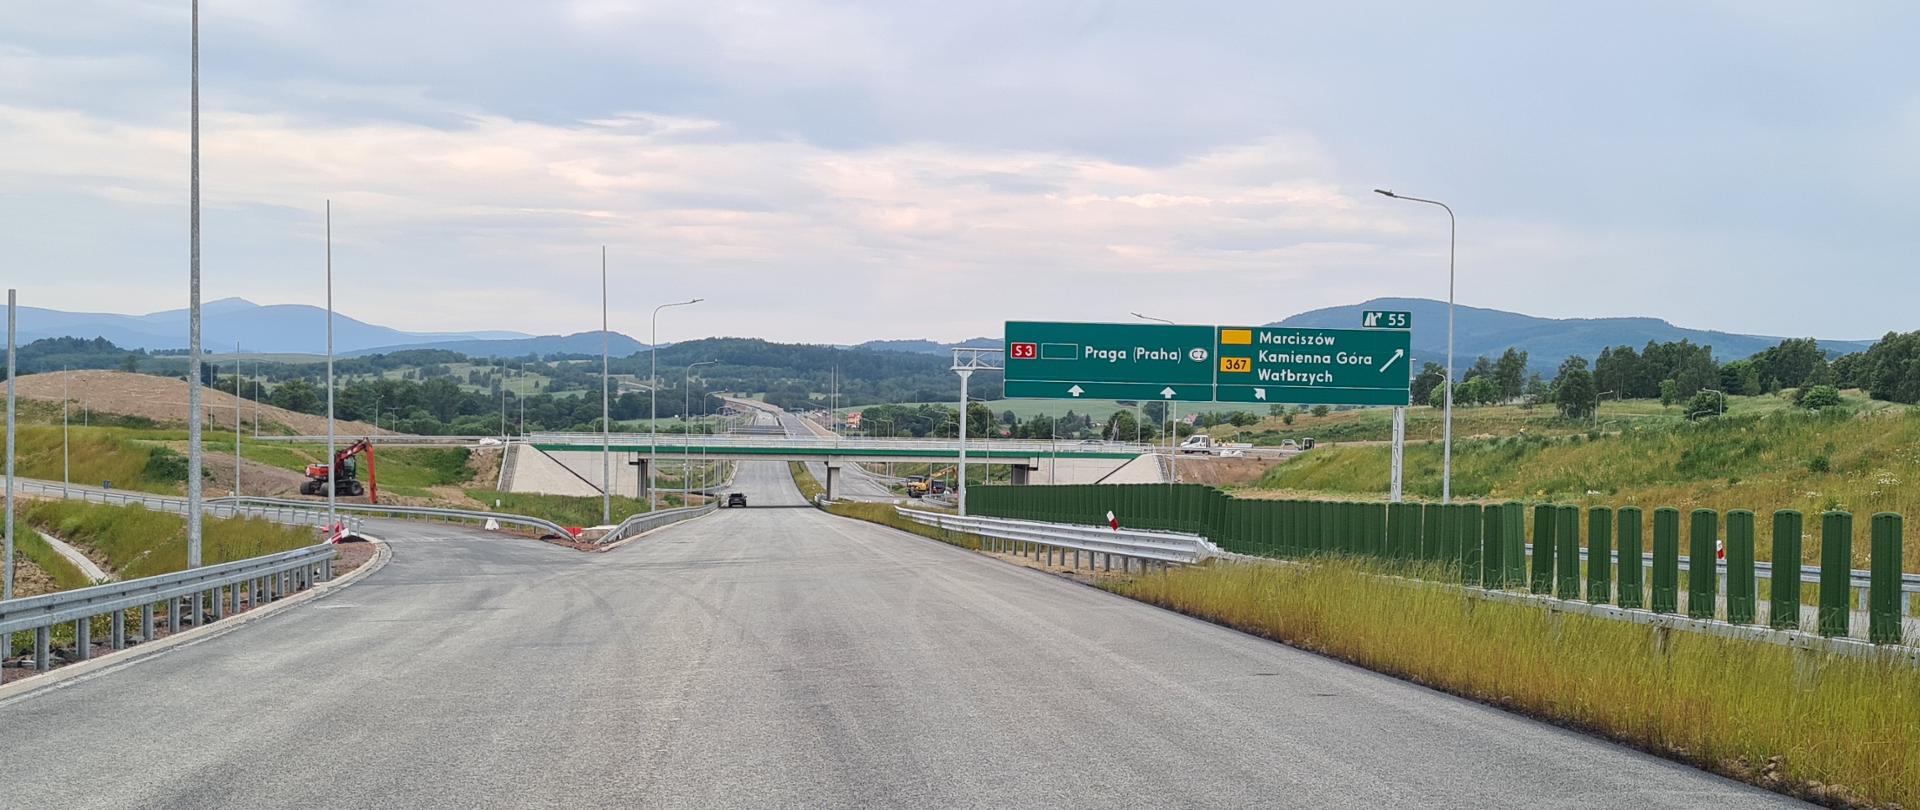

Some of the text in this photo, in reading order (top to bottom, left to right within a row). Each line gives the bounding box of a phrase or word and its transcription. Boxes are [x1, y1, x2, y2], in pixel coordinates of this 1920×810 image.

[1388, 313, 1406, 326] 55
[1259, 331, 1336, 346] Marciszów
[1084, 345, 1182, 364] Praga (Praha)
[1191, 350, 1205, 359] CZ
[1258, 349, 1373, 365] Kamienna Góra
[1225, 359, 1247, 370] 367
[1257, 368, 1333, 386] Wałbrzych
